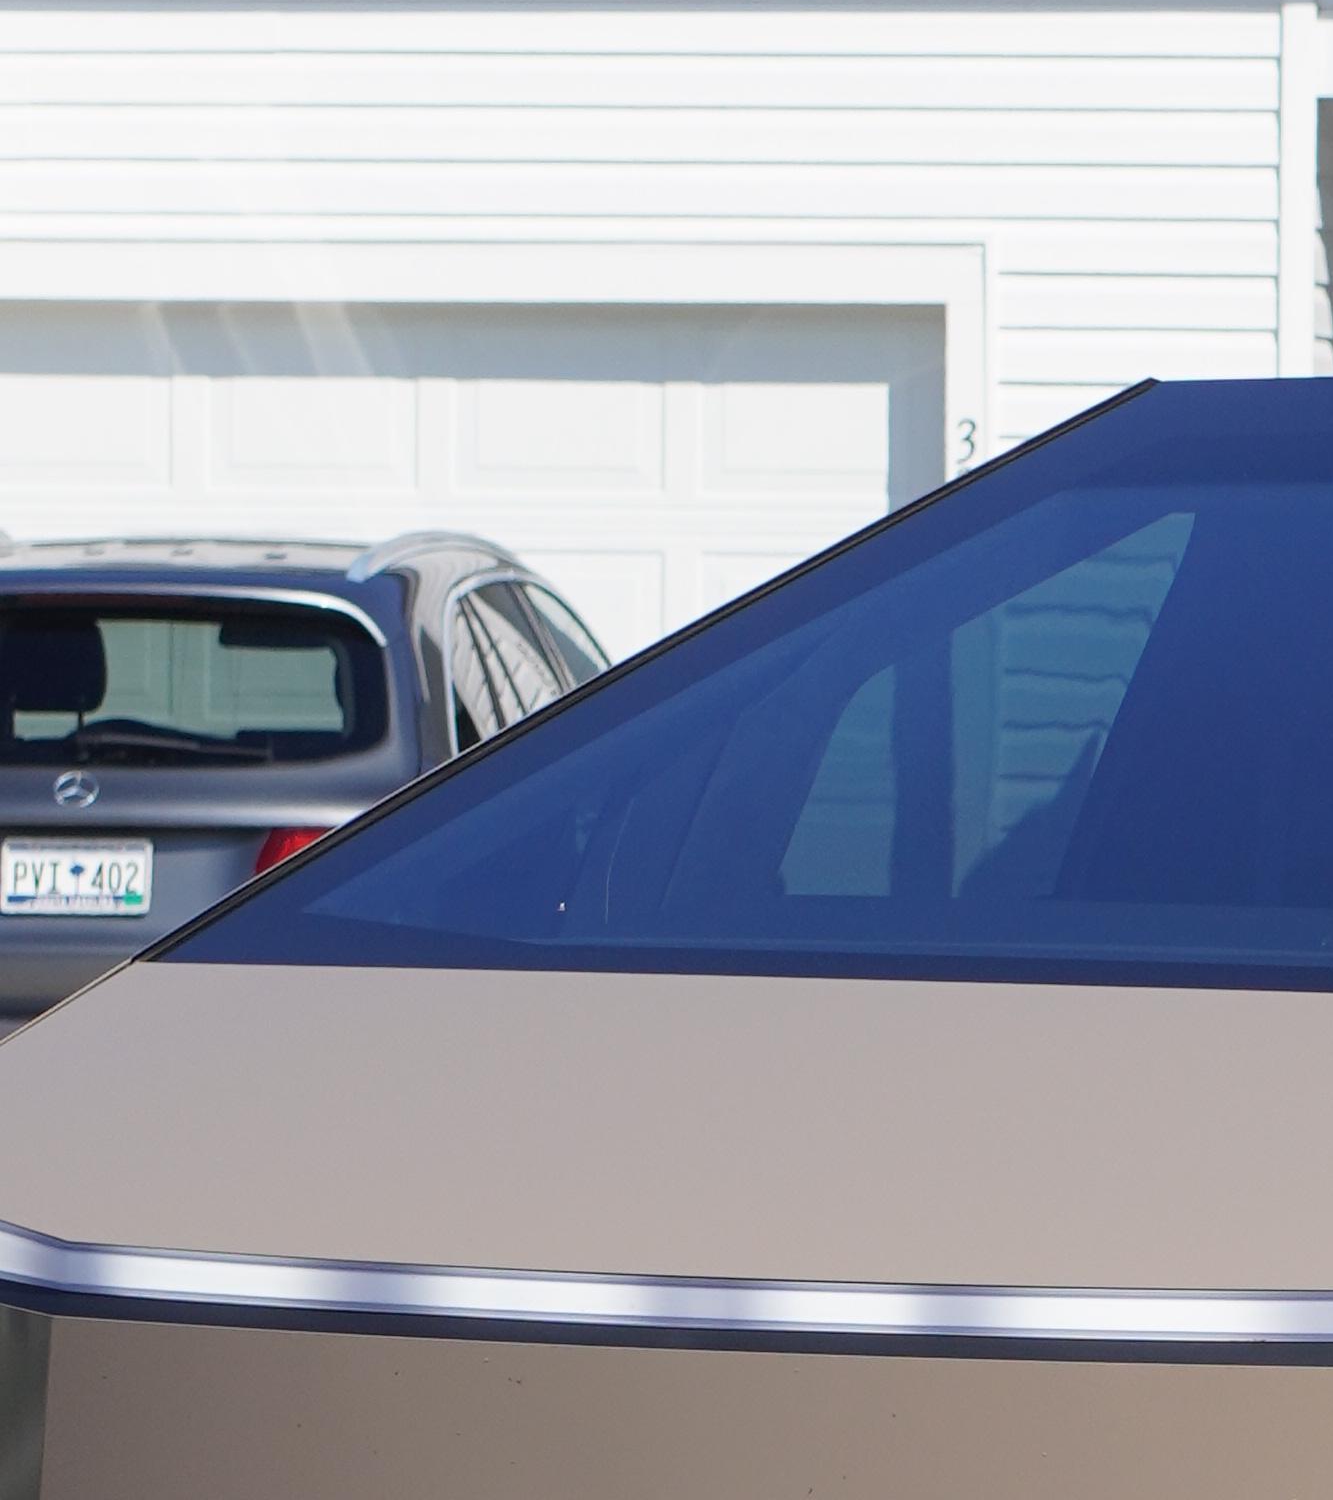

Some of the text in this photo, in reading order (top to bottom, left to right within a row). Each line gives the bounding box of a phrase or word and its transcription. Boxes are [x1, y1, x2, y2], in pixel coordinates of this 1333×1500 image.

[956, 418, 976, 475] 3
[13, 861, 139, 895] PVI 402
